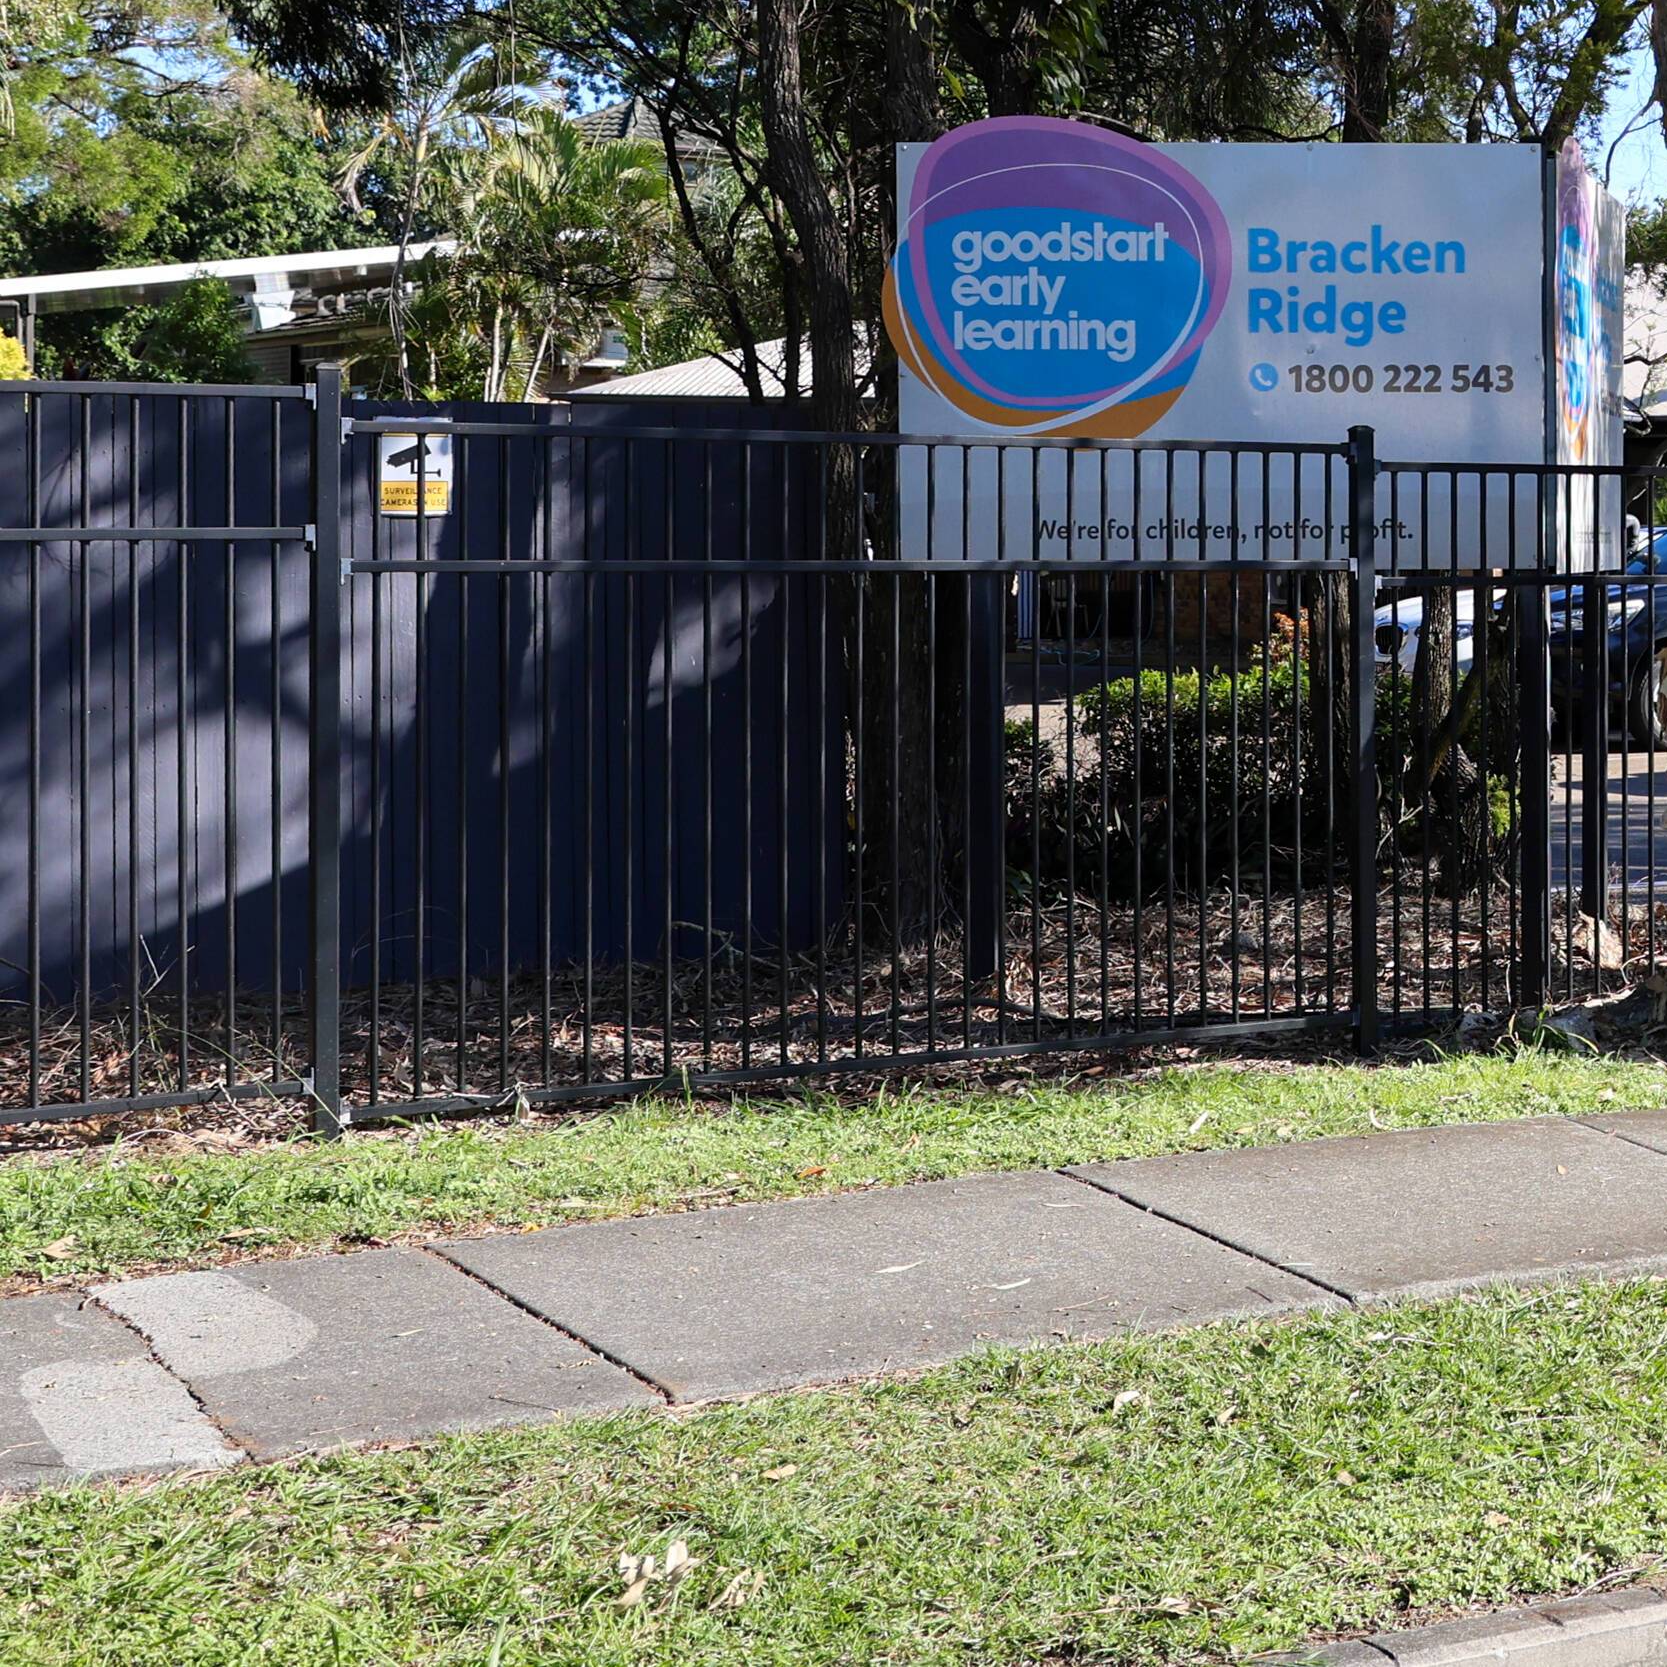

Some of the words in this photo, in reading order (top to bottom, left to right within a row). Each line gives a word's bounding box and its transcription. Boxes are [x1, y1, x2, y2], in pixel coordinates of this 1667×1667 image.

[952, 222, 1169, 273] goodstart
[1248, 225, 1465, 274] Bracken
[951, 266, 1066, 315] early
[954, 311, 1136, 362] learning
[1248, 285, 1406, 347] Ridge
[1288, 365, 1373, 393] 1800
[1383, 365, 1442, 393] 222
[1451, 365, 1514, 393] 543
[1254, 521, 1294, 540] not
